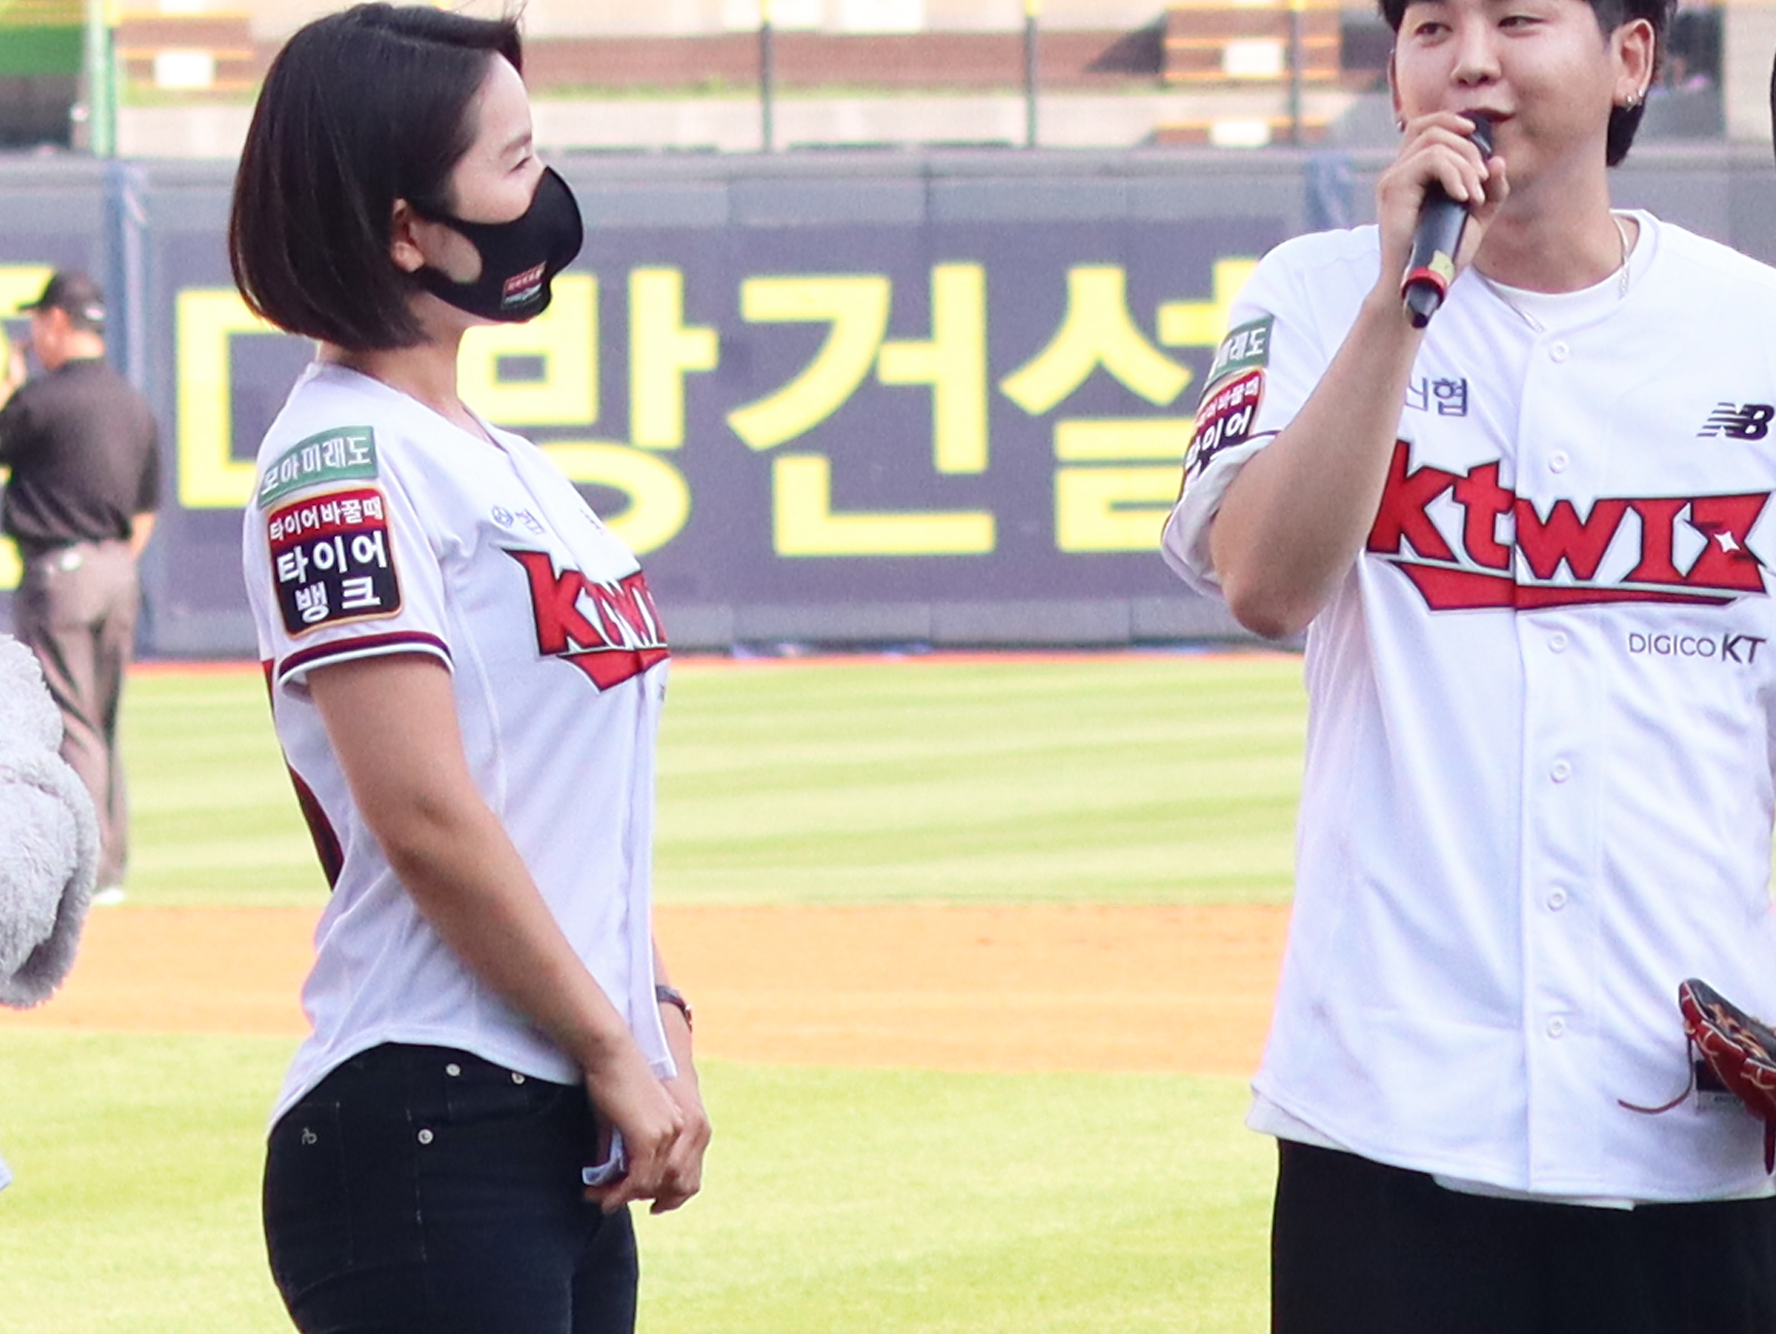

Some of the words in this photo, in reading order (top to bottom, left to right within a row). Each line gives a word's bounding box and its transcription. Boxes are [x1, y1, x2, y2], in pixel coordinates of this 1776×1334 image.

[276, 529, 388, 584] 타이어
[1628, 631, 1717, 658] DIGICO
[1721, 633, 1767, 664] KT
